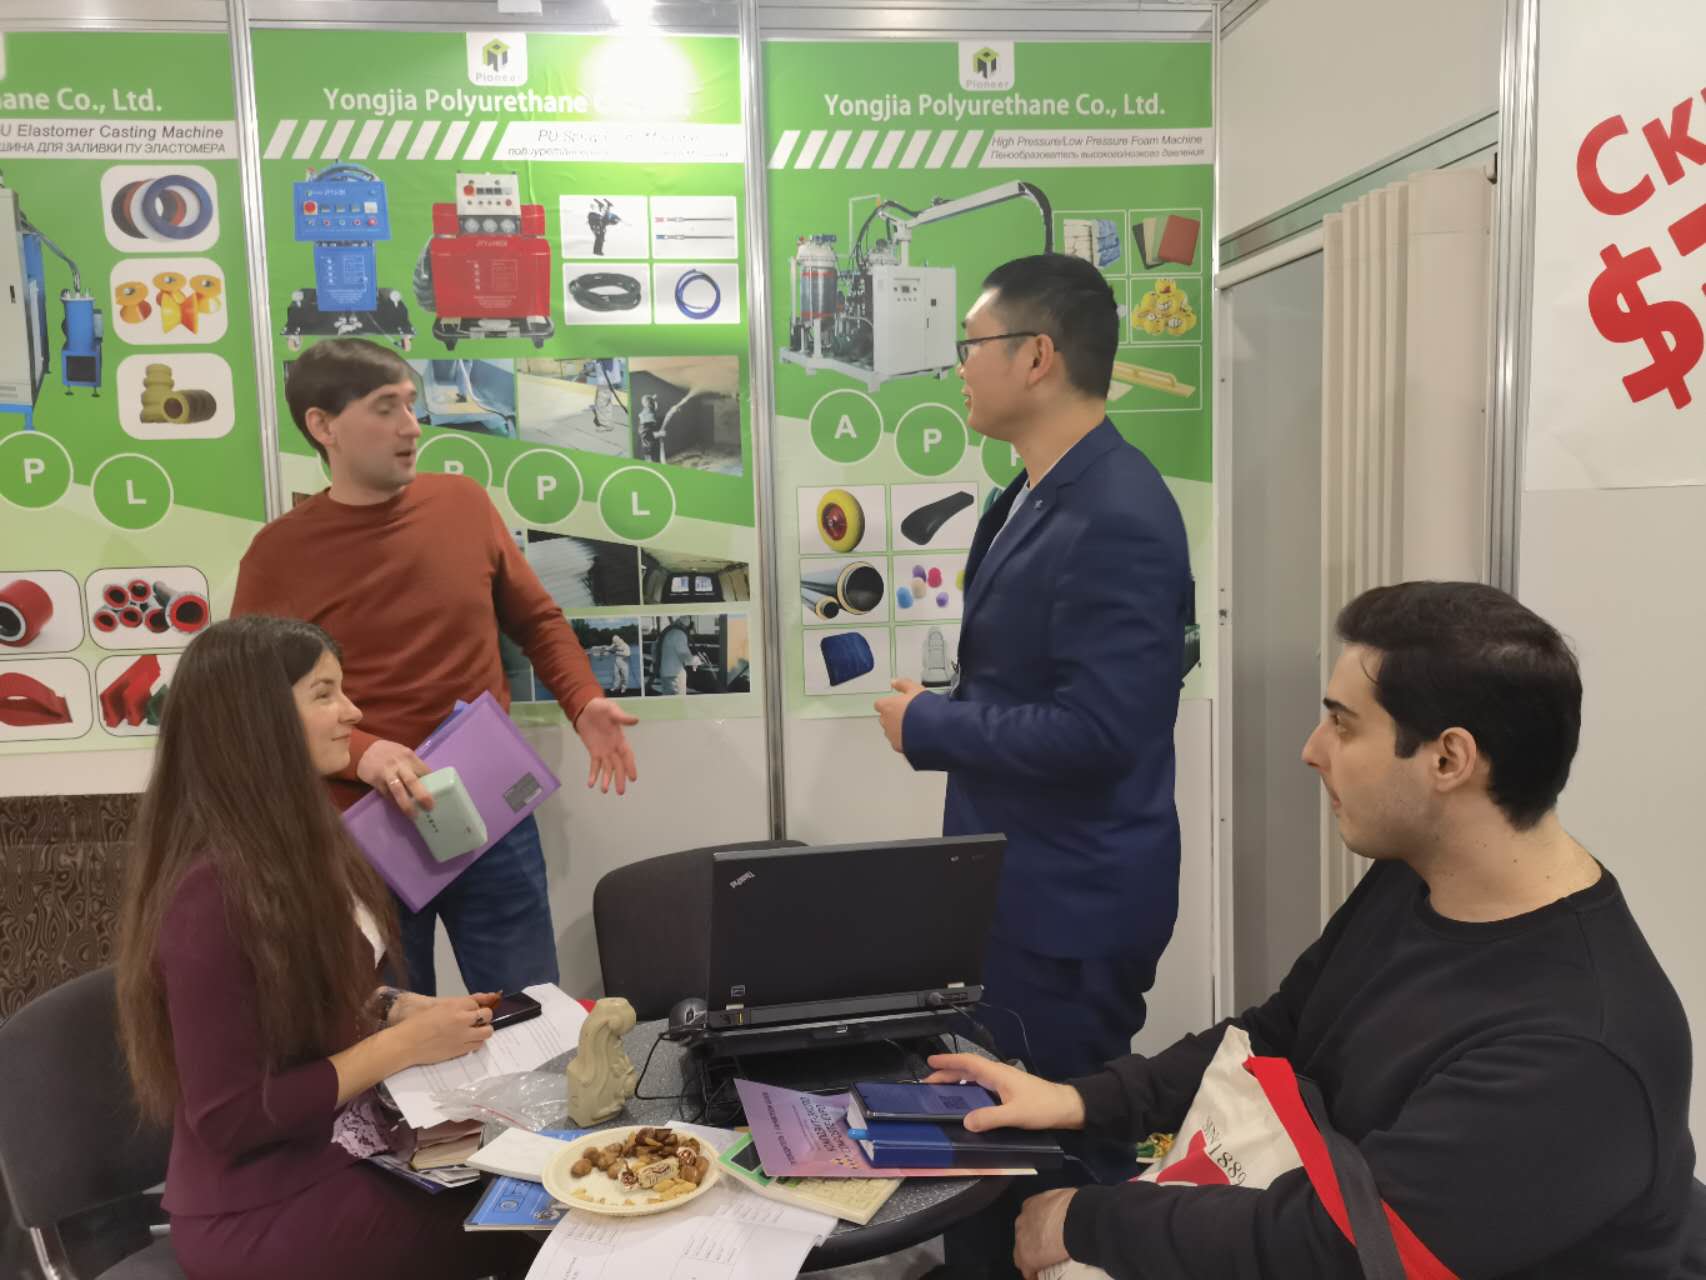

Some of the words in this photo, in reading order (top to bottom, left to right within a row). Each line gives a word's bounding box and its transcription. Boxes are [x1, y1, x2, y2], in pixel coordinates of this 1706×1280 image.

[966, 79, 1010, 89] Pioneer
[0, 91, 50, 111] ane
[57, 88, 106, 114] Co.,
[112, 88, 162, 112] Ltd.
[323, 88, 417, 116] Yongjia
[425, 88, 588, 117] Polyurethane
[824, 94, 911, 121] Yongjia
[919, 92, 1070, 121] Polyurethane
[1075, 93, 1117, 118] Co.,
[1124, 92, 1165, 115] Ltd.
[17, 124, 96, 138] Elastomer
[100, 125, 157, 141] Casting
[162, 126, 224, 139] Machine
[991, 136, 1015, 149] High
[1017, 136, 1084, 147] Pressure/Low
[1086, 136, 1128, 146] Pressure
[1131, 136, 1159, 146] Foam
[1161, 135, 1203, 146] Machine
[37, 142, 63, 154] ДЛЯ
[65, 142, 122, 154] ЗАЛИВКИ
[126, 143, 142, 153] ПУ
[146, 143, 226, 154] ЭЛАСТОМЕРА
[834, 414, 858, 440] A
[923, 428, 943, 454] P
[23, 458, 46, 485] P
[126, 479, 147, 505] L
[537, 475, 557, 501] P
[631, 491, 651, 517] L
